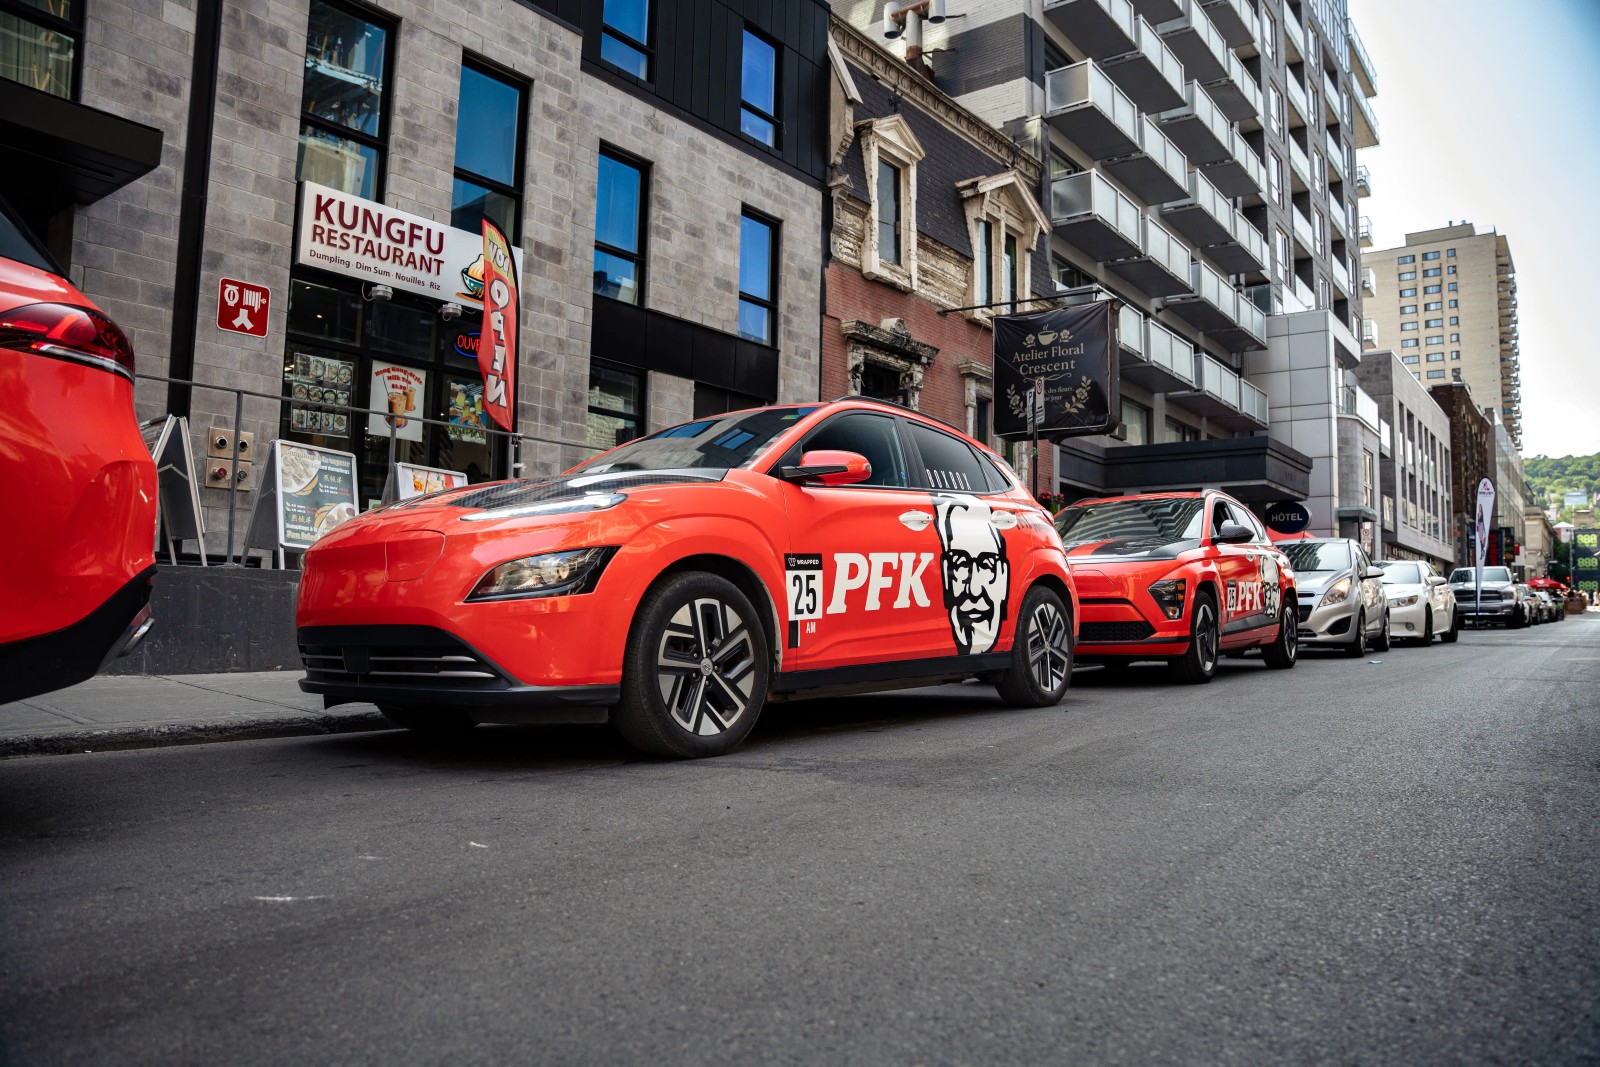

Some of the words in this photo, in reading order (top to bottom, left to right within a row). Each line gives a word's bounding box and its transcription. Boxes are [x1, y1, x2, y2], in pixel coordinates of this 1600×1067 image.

[314, 193, 445, 255] KUNGFU
[311, 223, 445, 277] RESTAURANT
[309, 249, 351, 268] Dumpling
[355, 261, 372, 273] Dim
[373, 266, 391, 278] Sum
[395, 272, 425, 287] Nouilles
[429, 281, 441, 291] Riz
[457, 334, 481, 352] OUVE
[1012, 349, 1049, 363] Atelier
[1051, 342, 1084, 358] Floral
[1020, 359, 1076, 376] Crescent
[1271, 512, 1303, 521] HÔTEL
[792, 574, 817, 615] 25
[826, 552, 934, 614] PFK
[1236, 581, 1262, 611] PFK
[805, 621, 816, 634] AM
